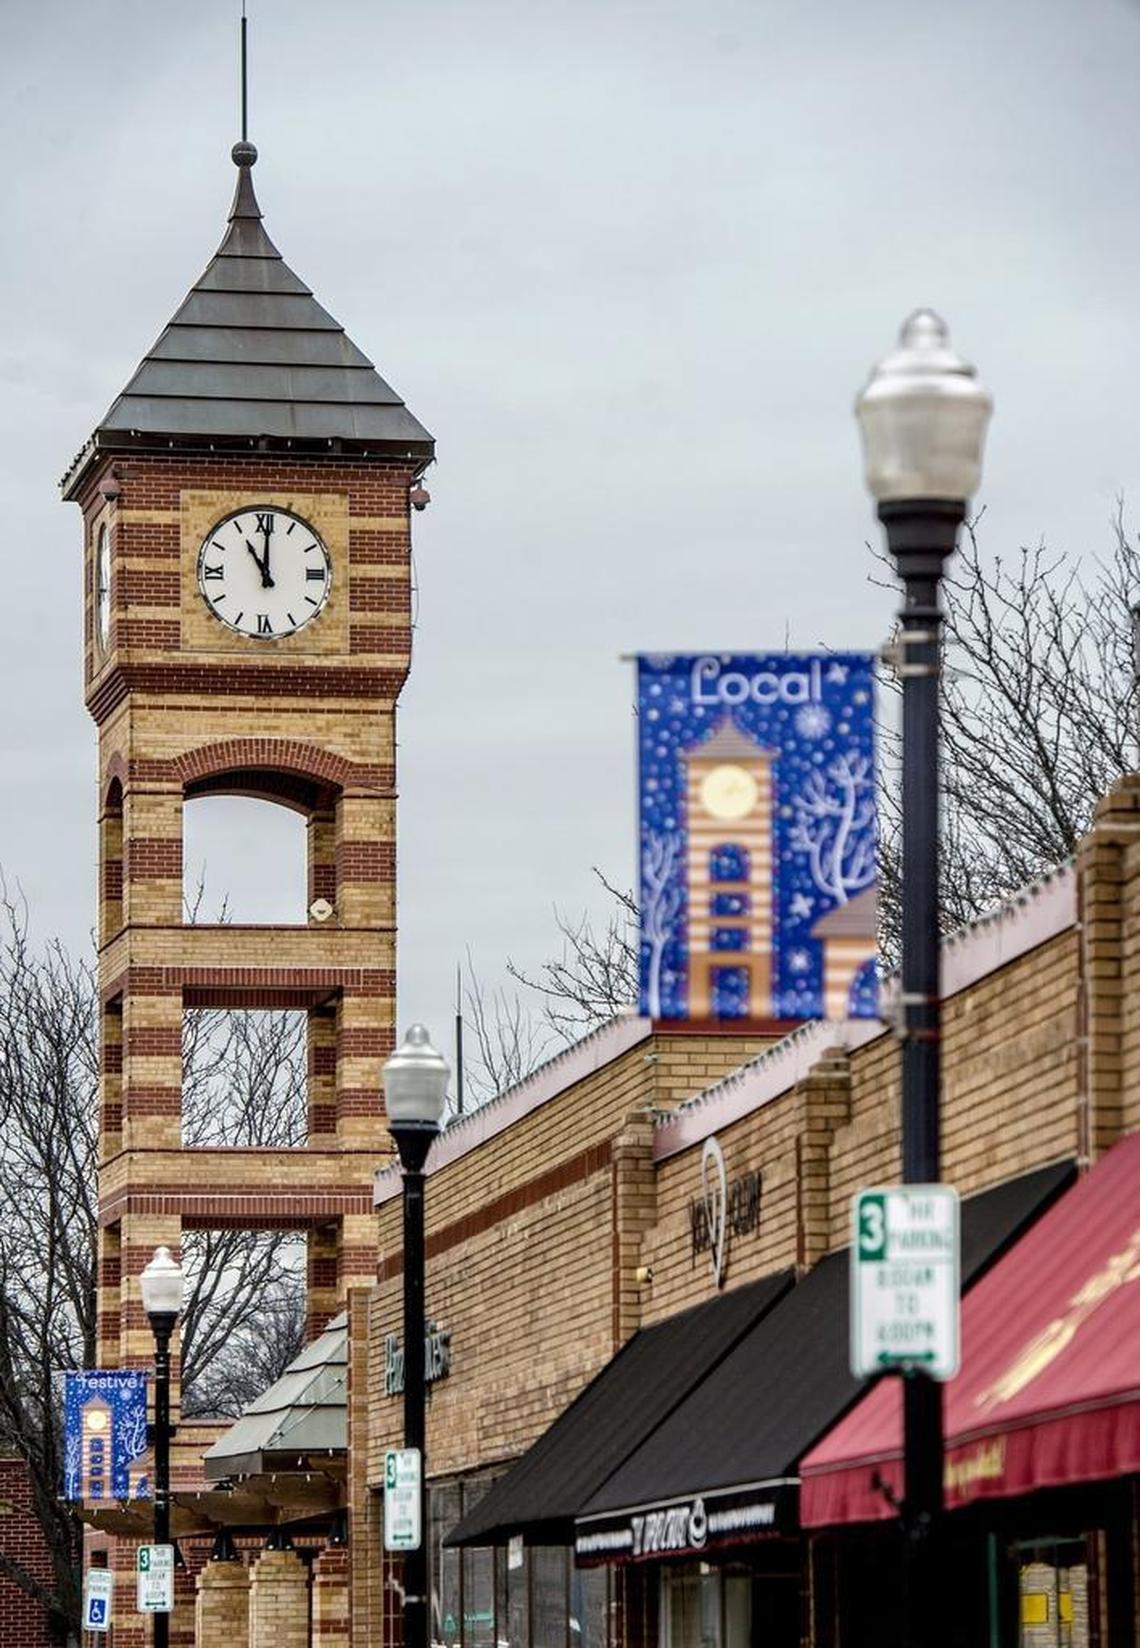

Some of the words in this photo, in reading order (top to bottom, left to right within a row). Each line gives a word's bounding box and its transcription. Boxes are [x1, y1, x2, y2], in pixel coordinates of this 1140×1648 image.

[691, 656, 821, 705] Local
[860, 1202, 884, 1252] 3
[140, 1550, 149, 1567] 3
